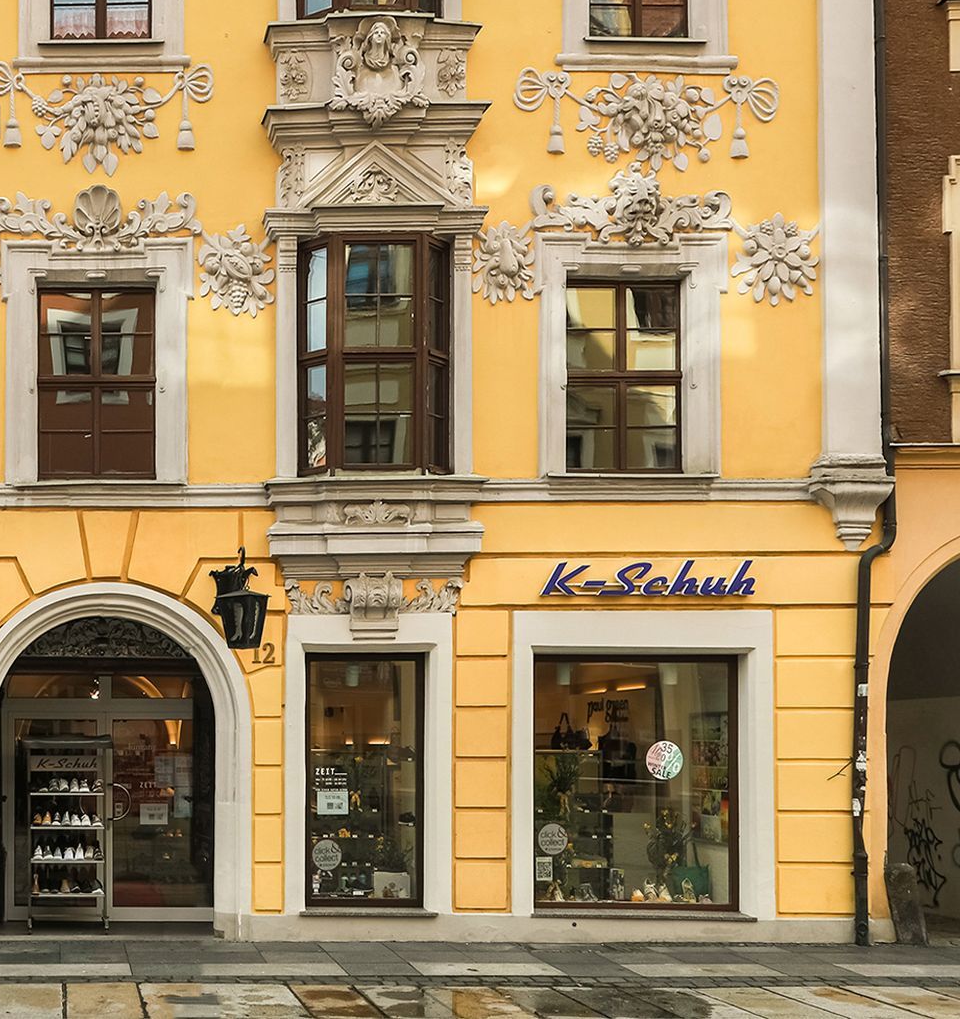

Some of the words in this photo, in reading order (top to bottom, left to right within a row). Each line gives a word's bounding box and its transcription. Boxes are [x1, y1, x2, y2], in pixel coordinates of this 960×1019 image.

[540, 559, 755, 596] K-Schuh
[252, 642, 275, 664] 12
[36, 757, 97, 769] K-Schuh
[651, 767, 672, 779] SALE
